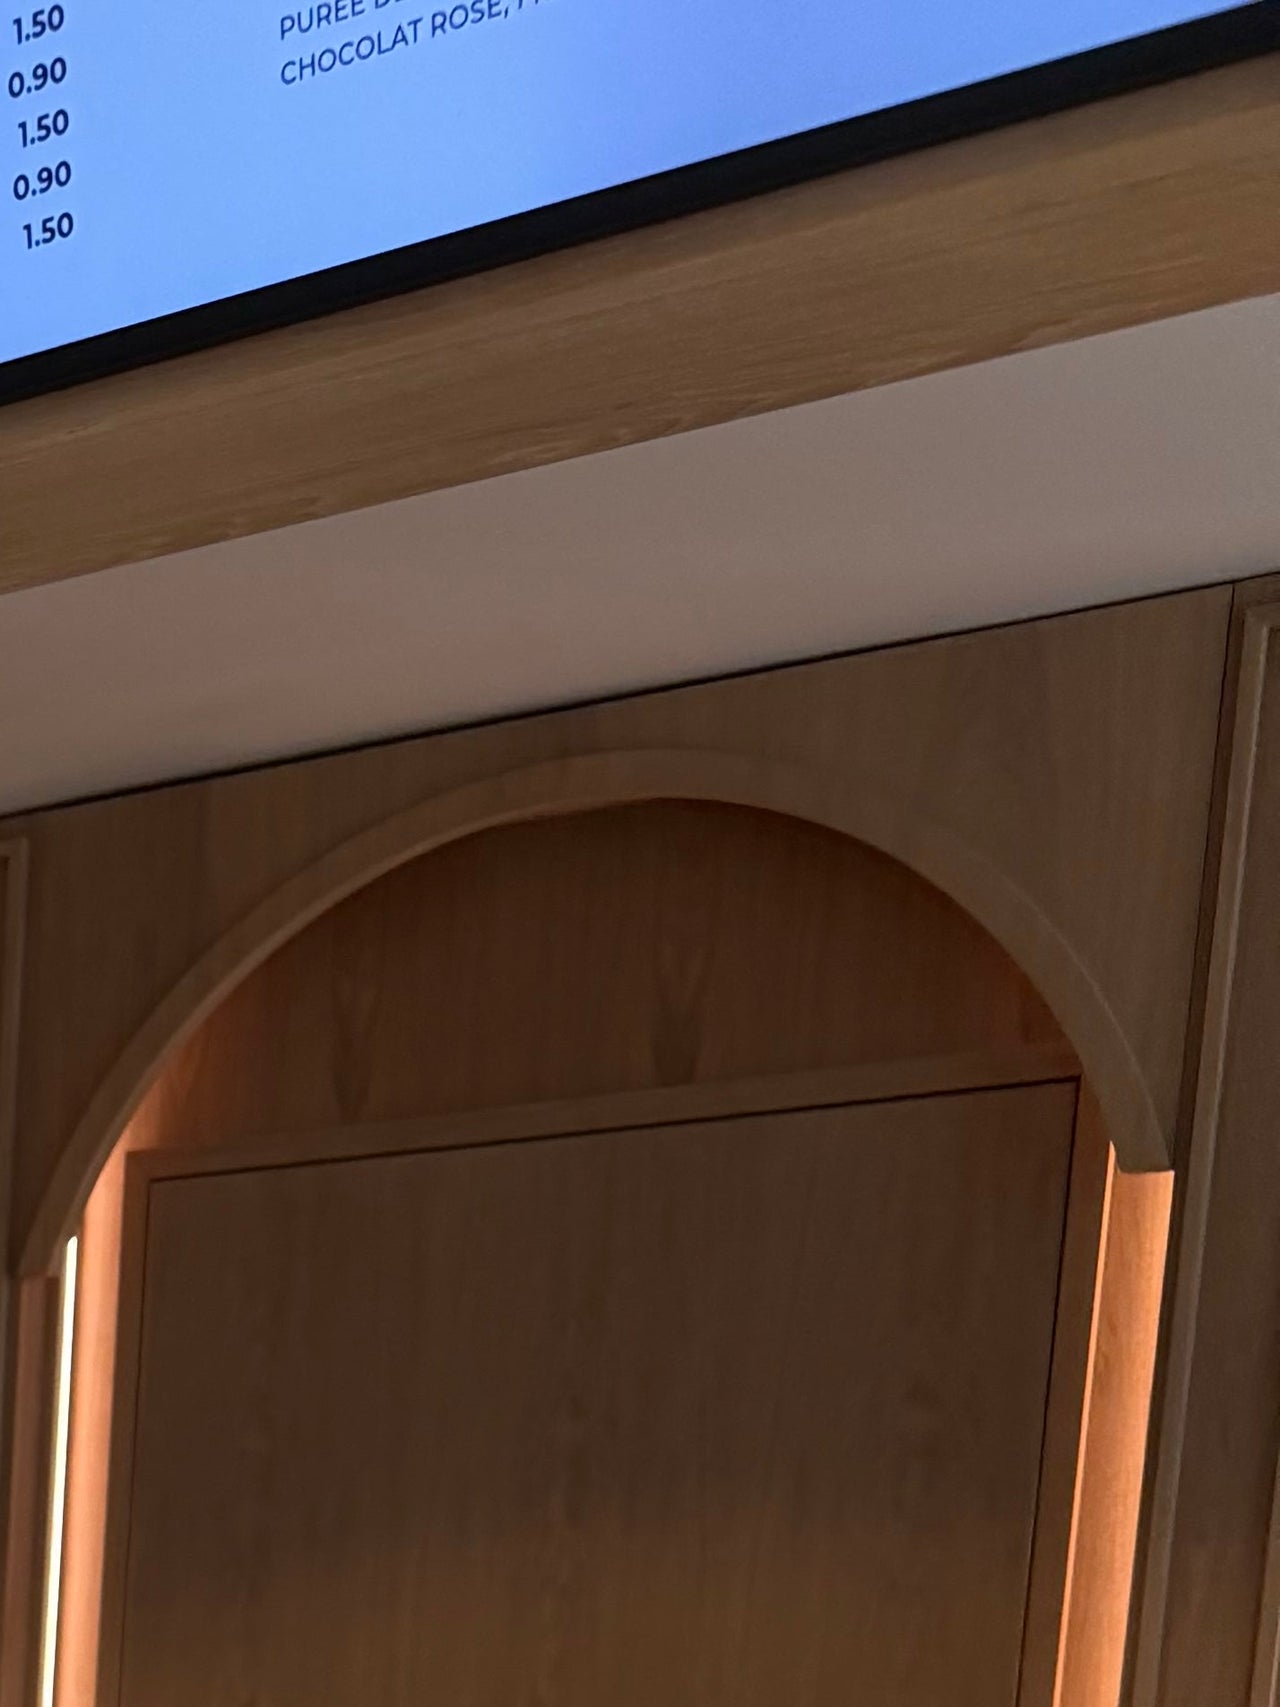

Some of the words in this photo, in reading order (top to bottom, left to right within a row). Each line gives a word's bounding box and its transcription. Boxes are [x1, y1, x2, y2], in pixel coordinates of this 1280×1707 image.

[13, 4, 65, 45] 1.50
[280, 17, 423, 85] CHOCOLAT
[431, 0, 510, 38] ROSE,
[7, 56, 67, 98] 0.90
[17, 108, 69, 148] 1.50
[12, 159, 71, 200] 0.90
[22, 211, 74, 249] 1.50
